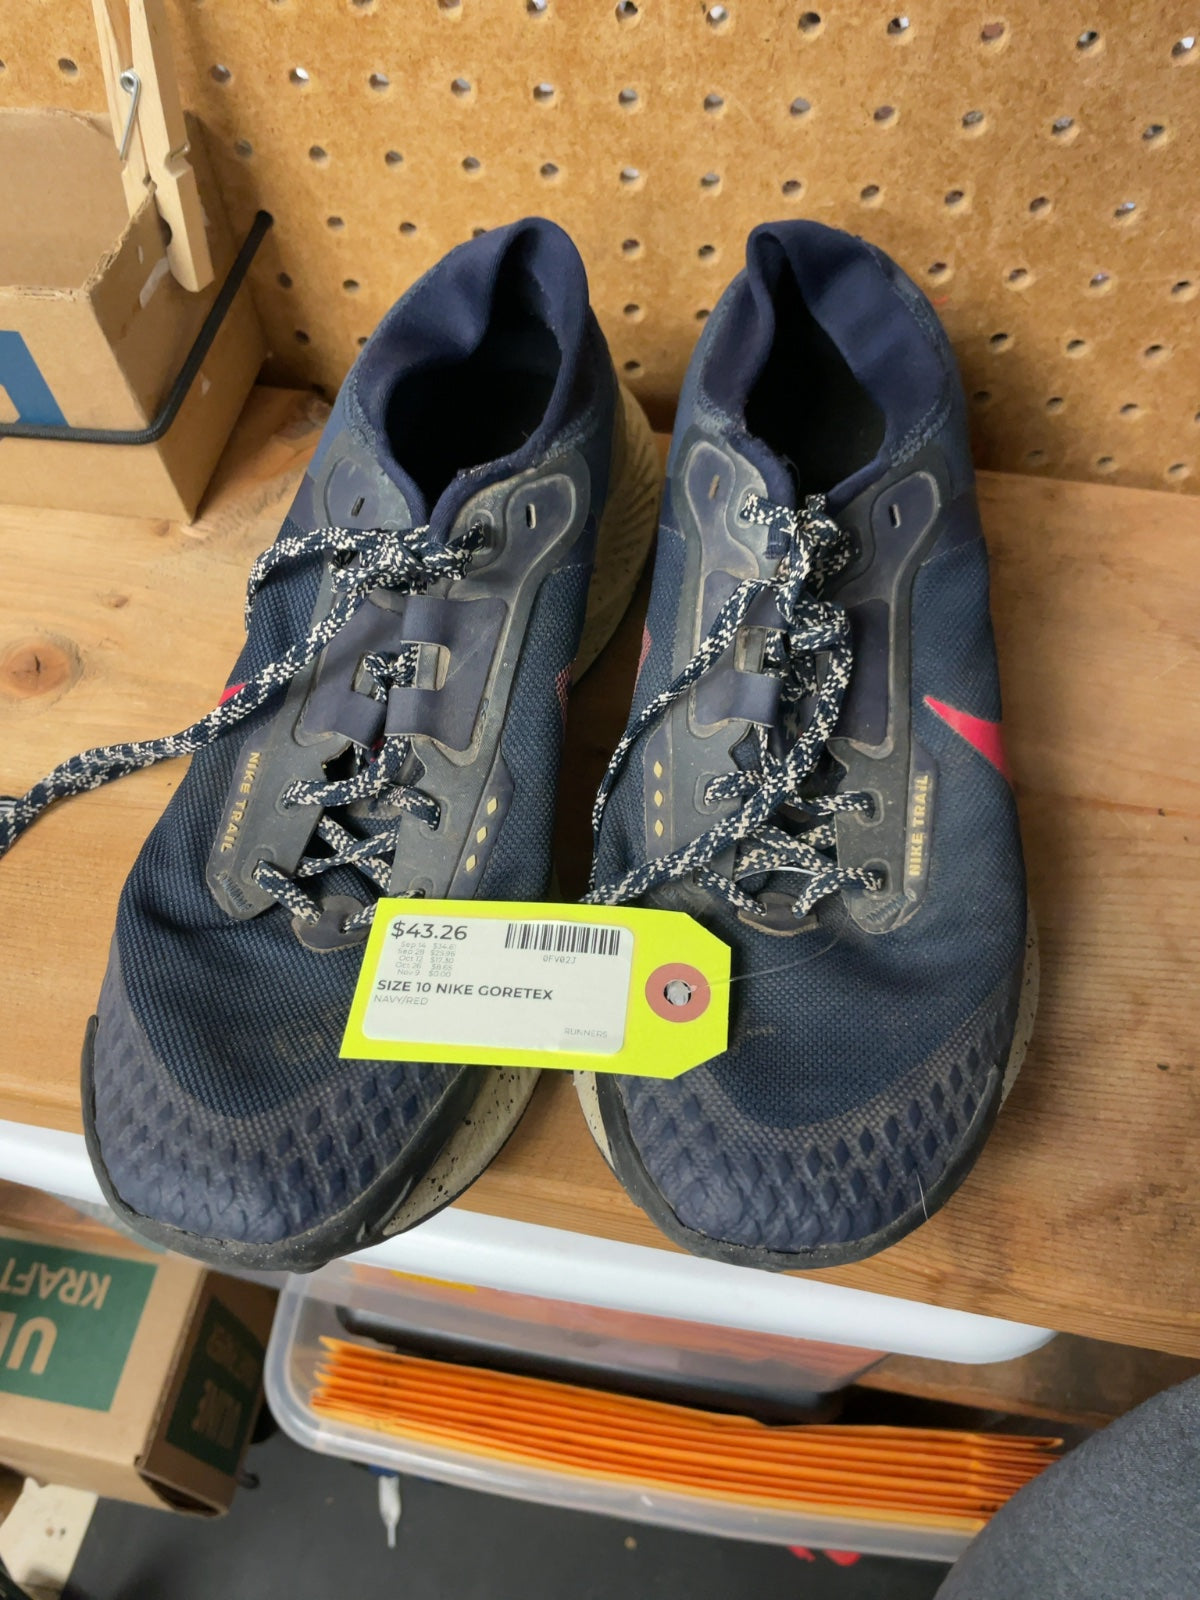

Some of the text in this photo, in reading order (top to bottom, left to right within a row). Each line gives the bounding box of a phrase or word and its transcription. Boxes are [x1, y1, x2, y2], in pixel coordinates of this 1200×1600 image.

[220, 752, 260, 853] NIKE TRAIL
[909, 775, 929, 877] NIKE TRAIL
[391, 920, 468, 940] $43.26
[377, 979, 554, 1000] SIZE 10 NIKE GORETEX
[373, 994, 429, 1006] NAVY/RED
[564, 1027, 608, 1039] RUNNERS
